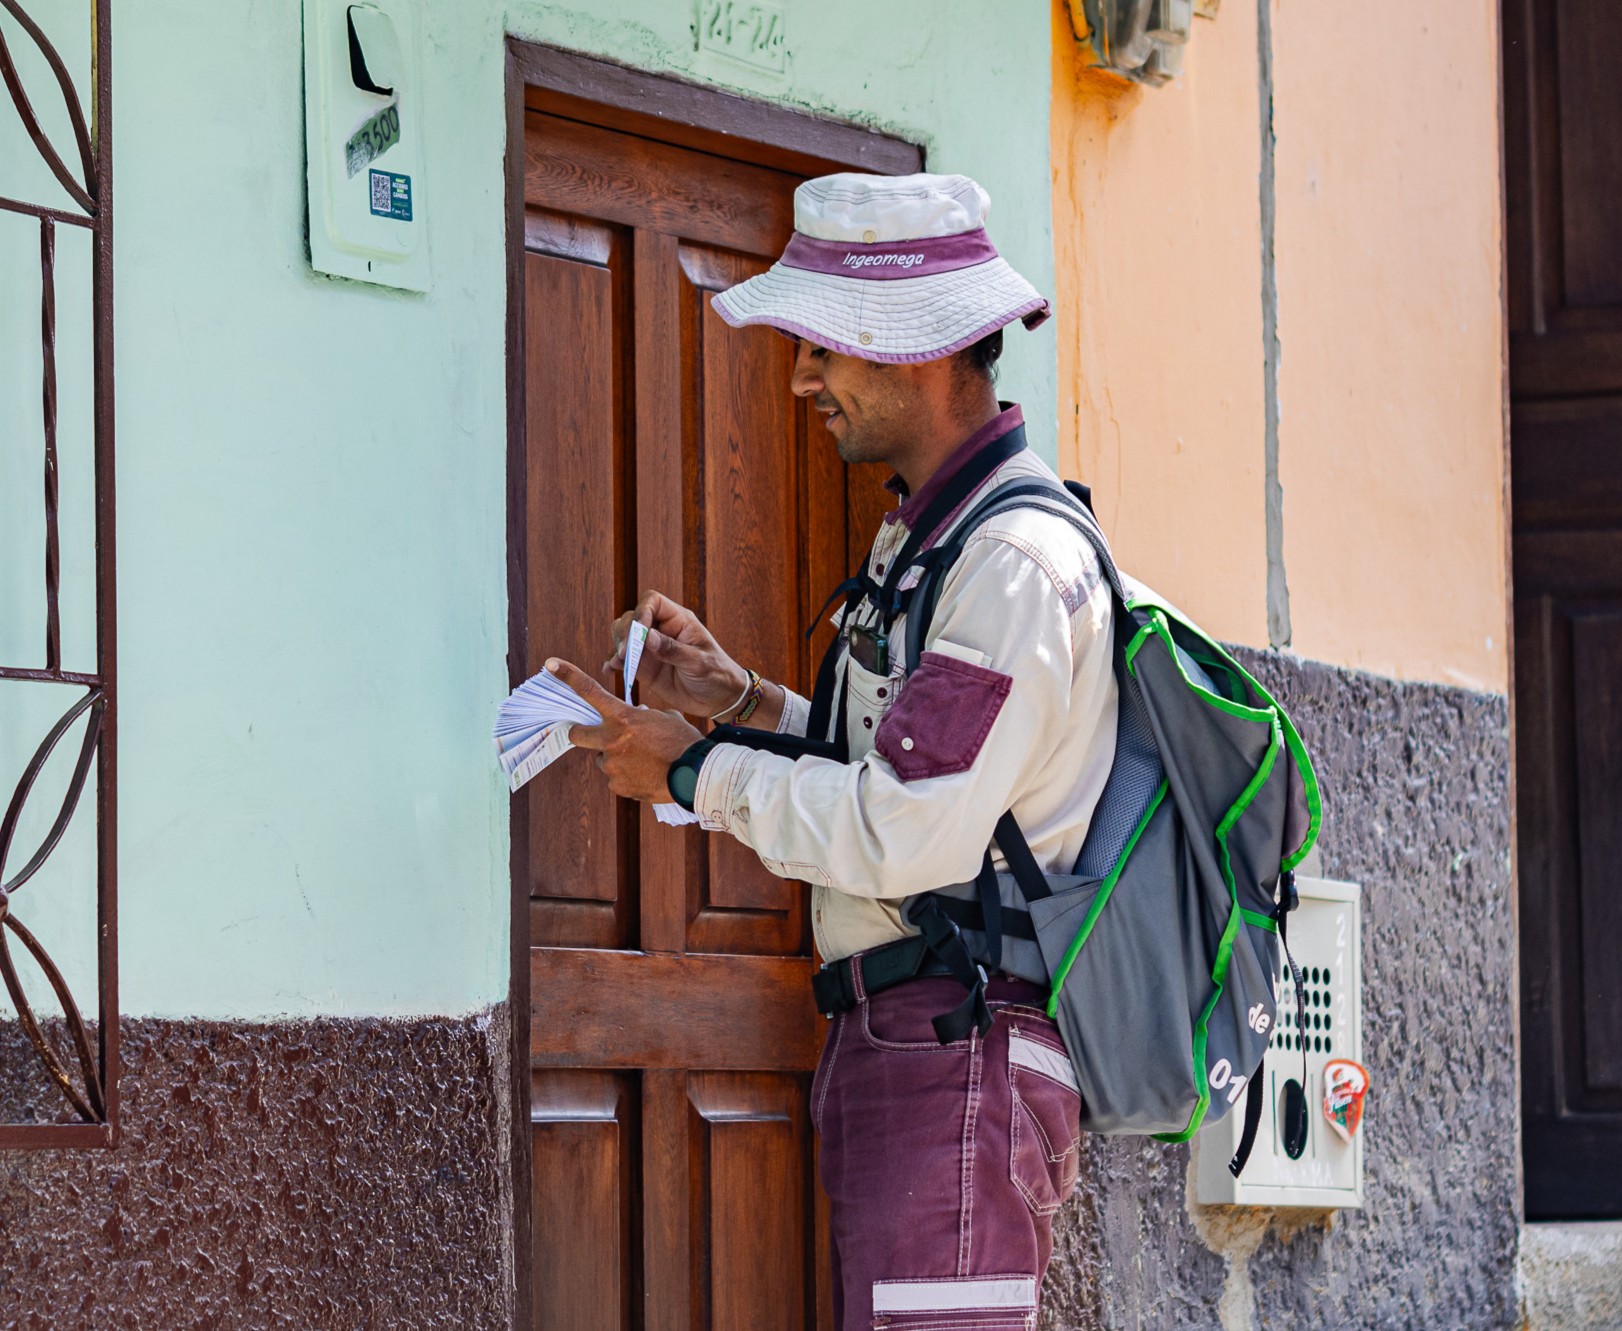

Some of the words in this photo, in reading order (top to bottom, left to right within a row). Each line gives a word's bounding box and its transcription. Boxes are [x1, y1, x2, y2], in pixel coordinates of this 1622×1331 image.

[842, 252, 925, 269] Ingeomega
[1248, 1003, 1270, 1034] de
[1209, 1058, 1248, 1104] 01
